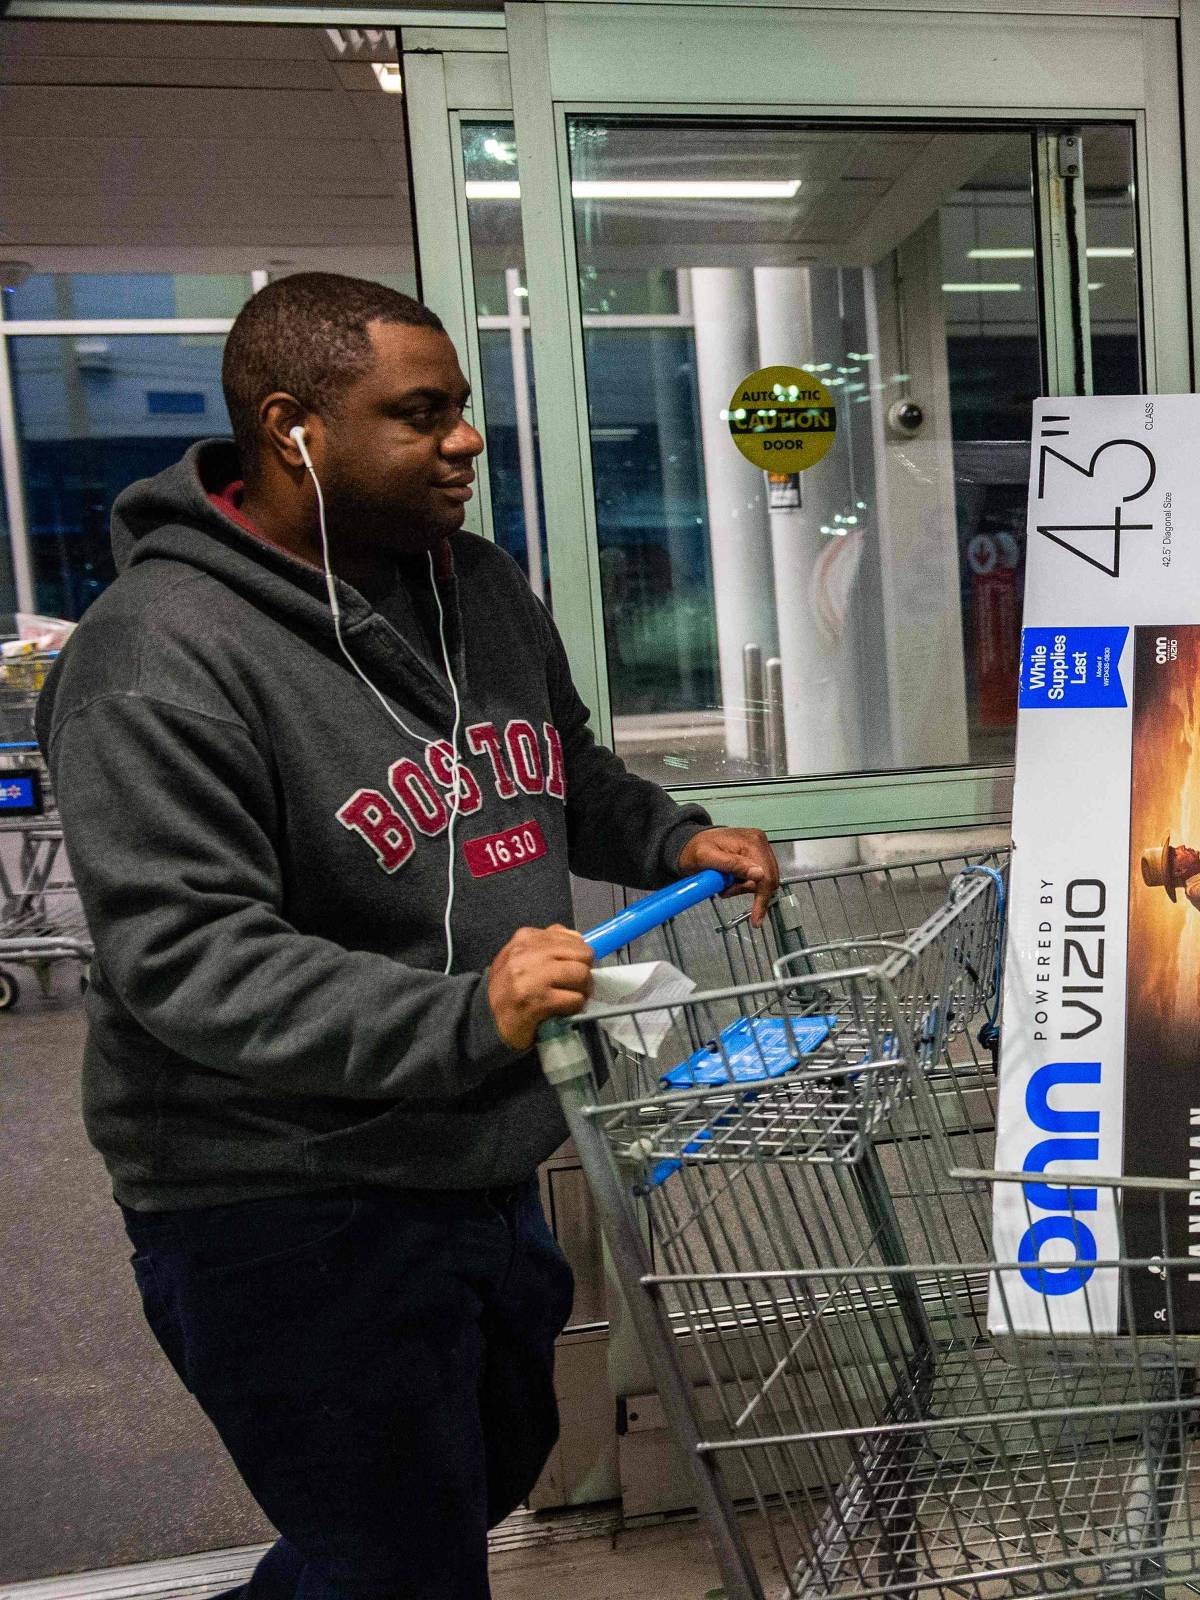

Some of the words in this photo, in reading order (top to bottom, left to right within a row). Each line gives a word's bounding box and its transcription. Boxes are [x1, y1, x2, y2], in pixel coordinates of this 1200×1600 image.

[742, 390, 820, 402] AUTOTIC
[735, 410, 829, 430] CAUTION
[1145, 402, 1154, 430] CLASS
[764, 440, 804, 451] DOOR
[1036, 416, 1156, 578] 43"
[1163, 492, 1172, 508] Size
[1163, 510, 1173, 545] Diagonal
[1156, 637, 1167, 664] onn
[1030, 646, 1046, 690] While
[1048, 635, 1069, 700] Supplies
[1070, 652, 1087, 684] Last
[485, 830, 536, 866] 1630
[1040, 879, 1054, 904] BY
[1061, 878, 1106, 1040] VIZIO
[1034, 921, 1052, 1040] POWERED
[1018, 1062, 1102, 1296] onn
